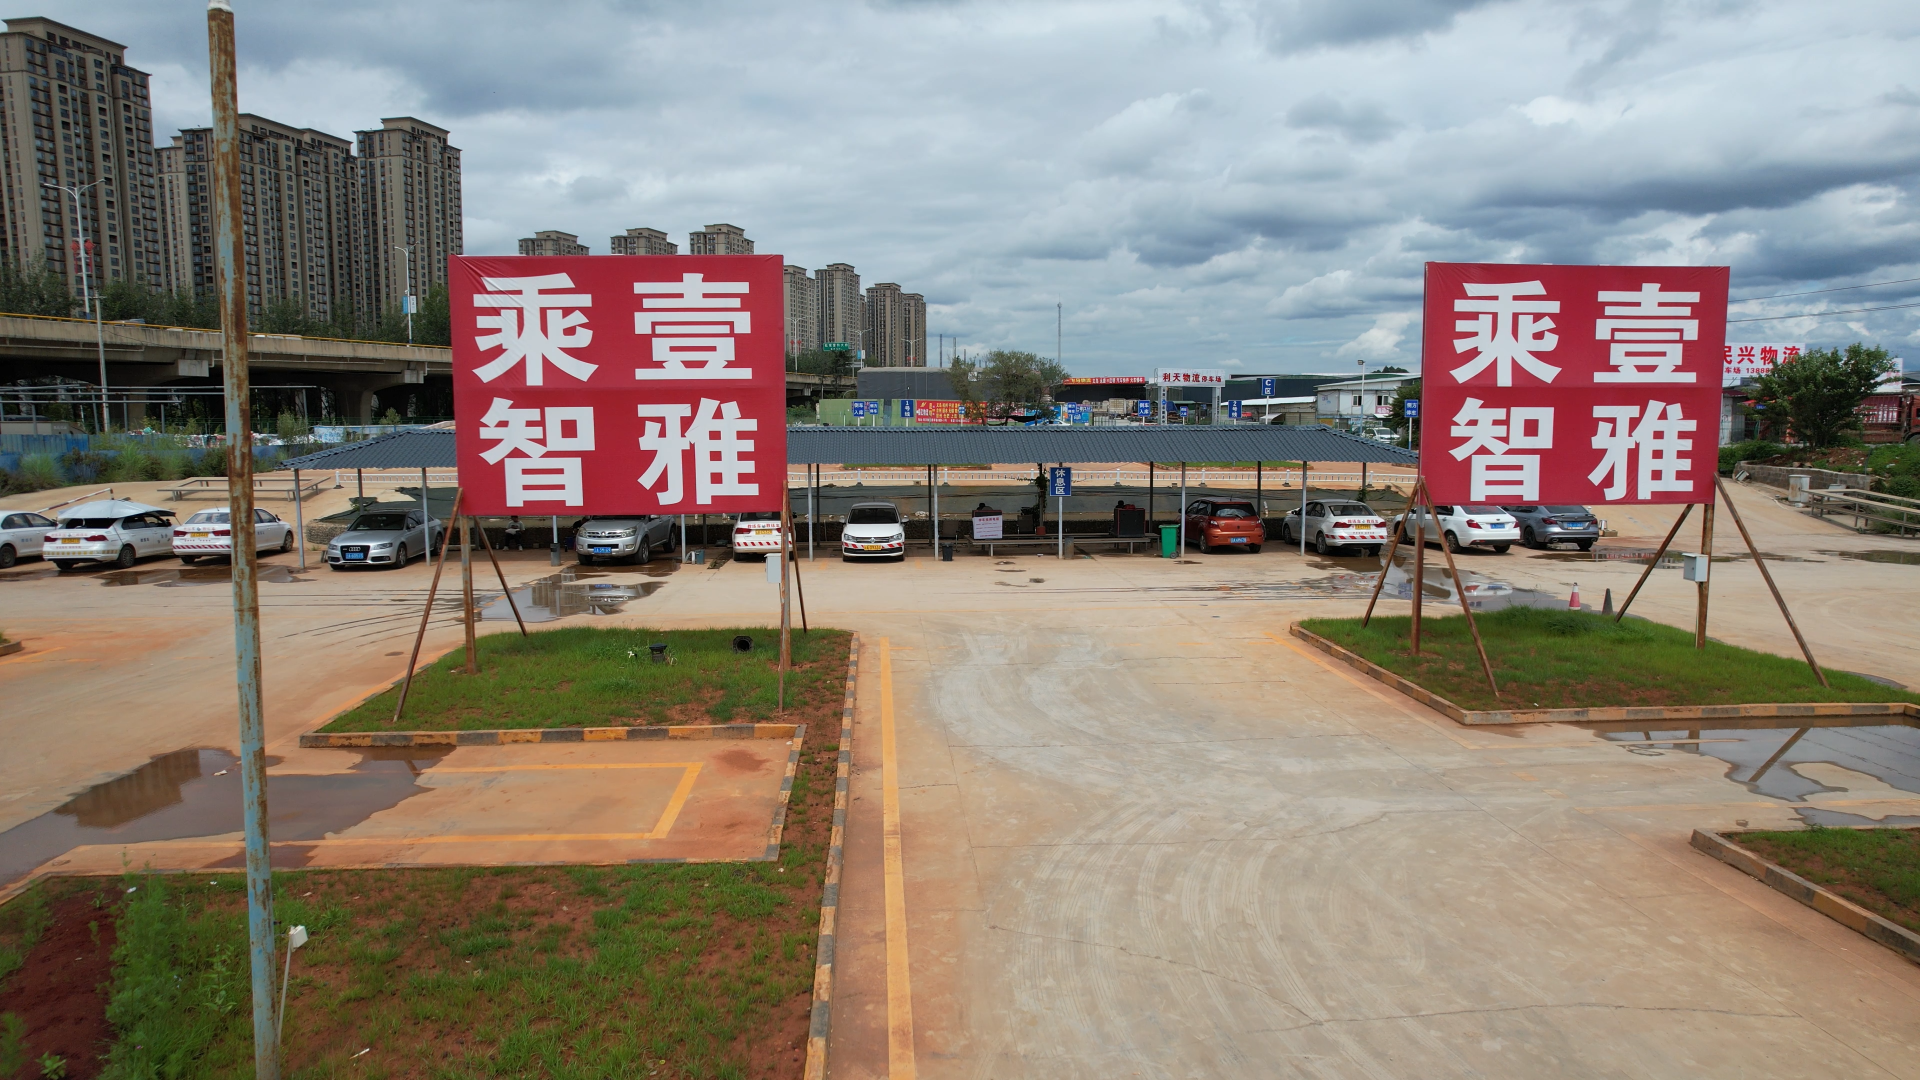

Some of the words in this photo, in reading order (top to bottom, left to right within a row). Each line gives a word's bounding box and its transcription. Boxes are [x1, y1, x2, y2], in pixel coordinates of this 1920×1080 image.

[472, 272, 752, 386] 乘壹
[1449, 280, 1700, 387] 乘壹
[478, 397, 759, 507] 智雅
[1055, 468, 1066, 495] 休息区
[1448, 397, 1697, 502] 智雅
